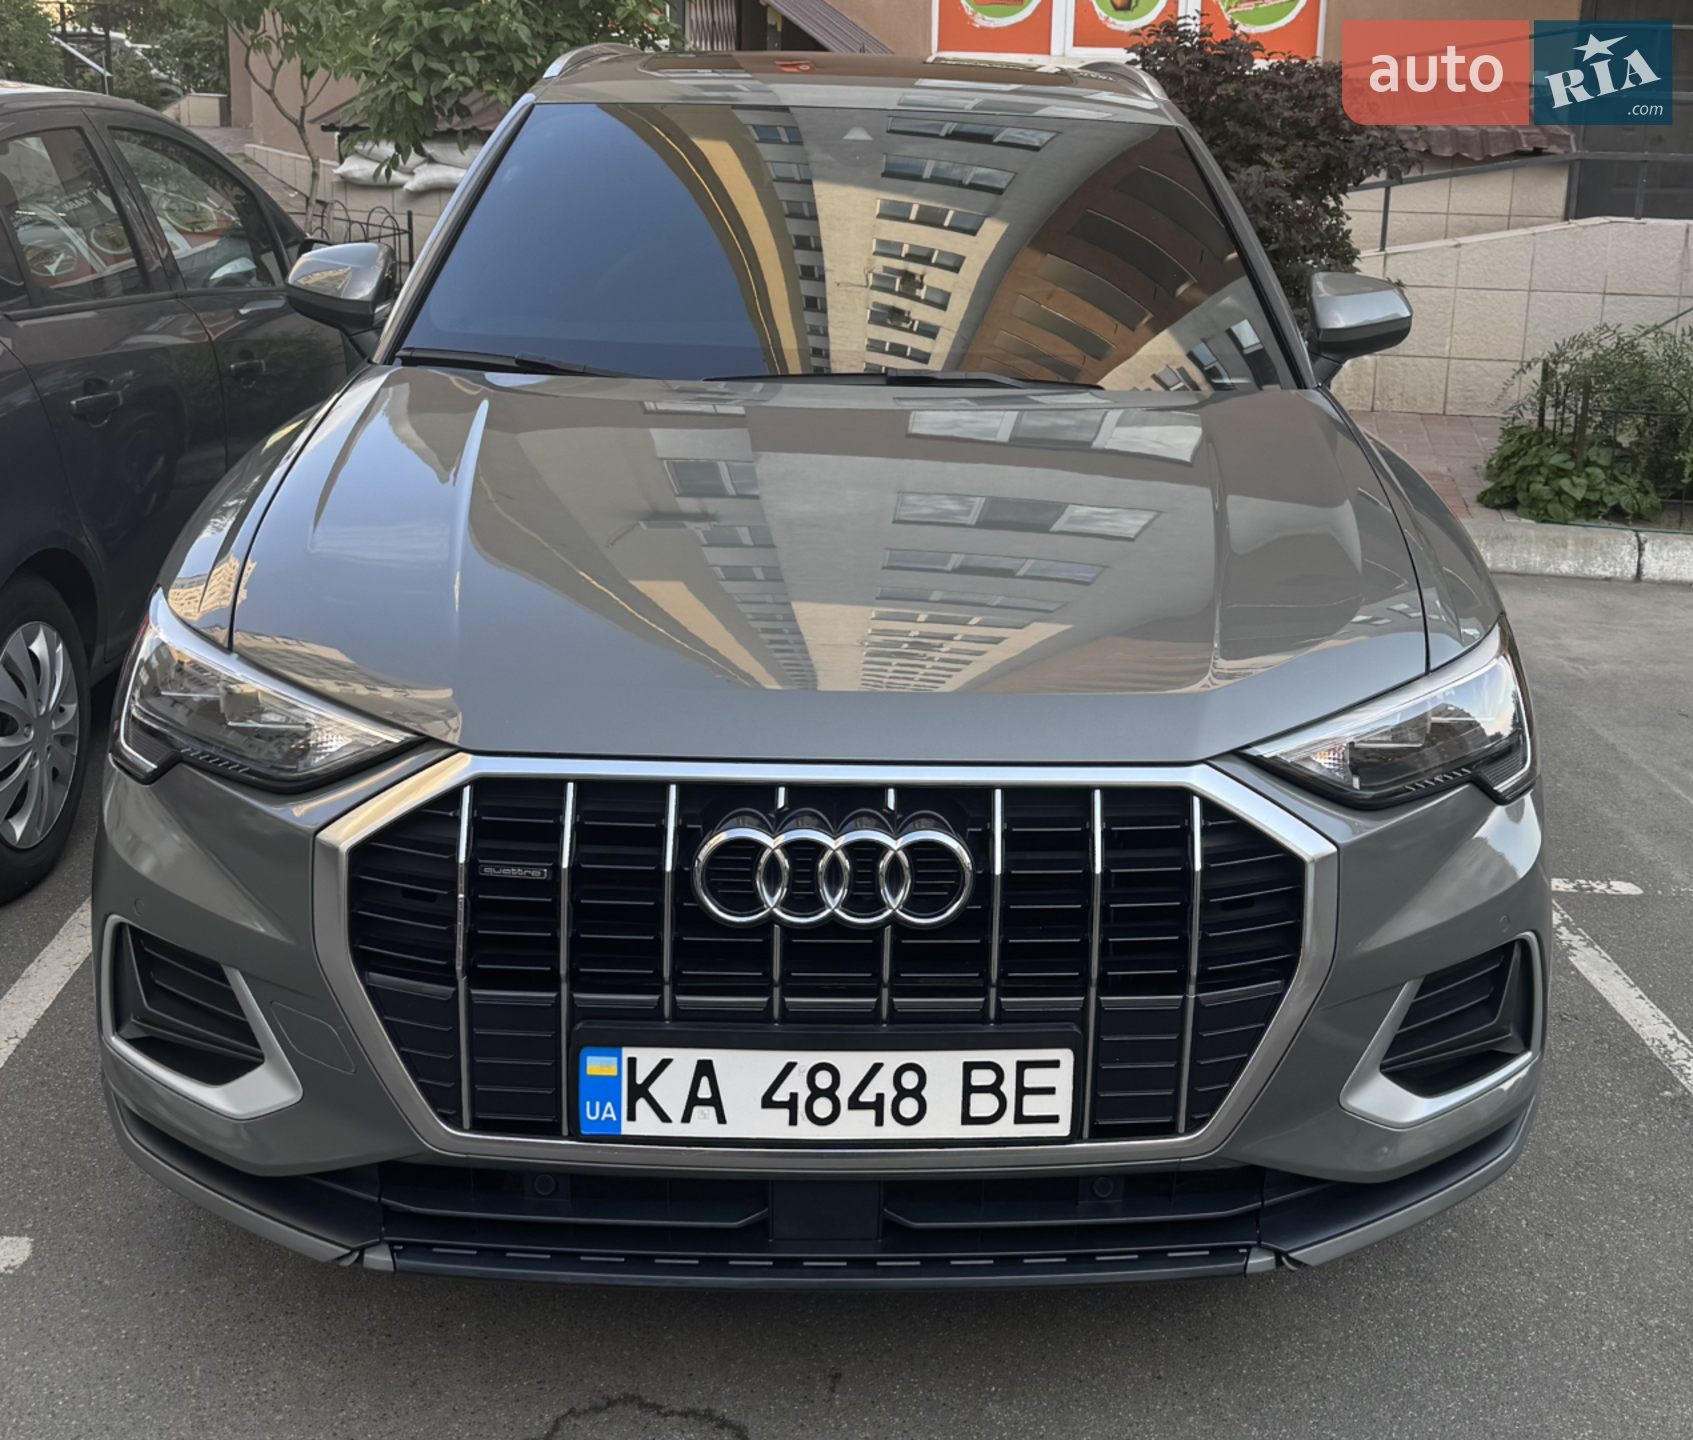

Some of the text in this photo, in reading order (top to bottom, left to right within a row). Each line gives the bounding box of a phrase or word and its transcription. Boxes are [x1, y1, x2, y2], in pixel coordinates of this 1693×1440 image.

[483, 867, 541, 877] quattro
[626, 1056, 1061, 1127] KA 4848 BE
[586, 1100, 617, 1121] UA
